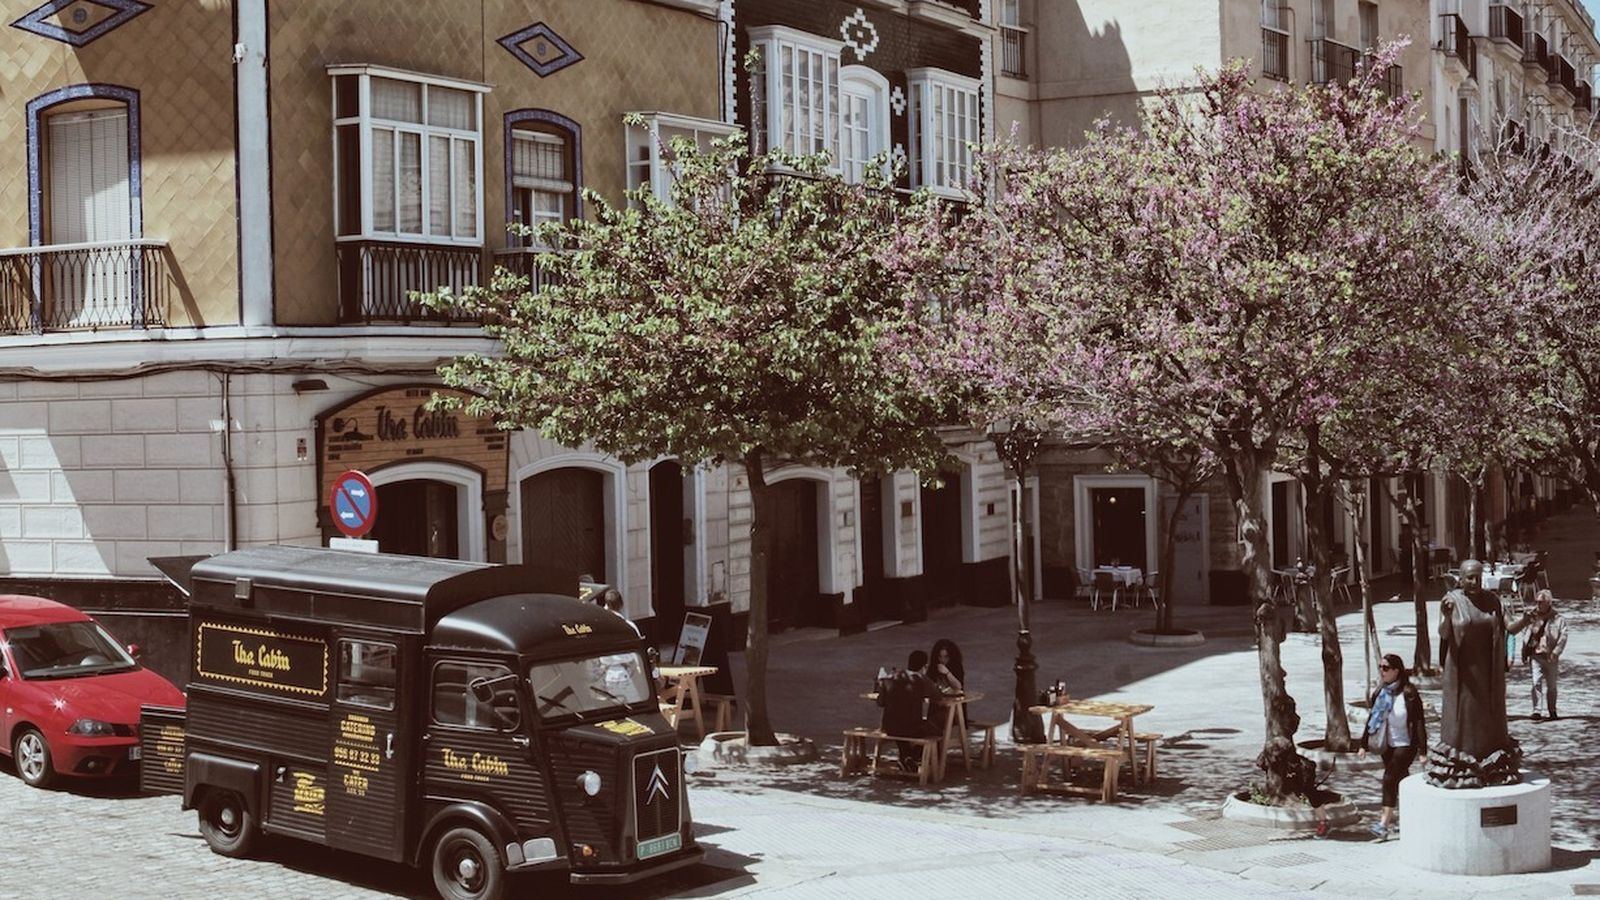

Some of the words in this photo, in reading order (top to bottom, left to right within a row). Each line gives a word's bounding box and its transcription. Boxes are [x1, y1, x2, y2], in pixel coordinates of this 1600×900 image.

[375, 406, 408, 441] The
[562, 624, 577, 635] The
[575, 624, 592, 634] Cabin
[232, 640, 255, 665] The
[258, 645, 290, 671] Cabin
[341, 720, 376, 736] CATERING
[441, 748, 467, 770] The
[472, 752, 508, 776] Cabin
[343, 774, 368, 790] CATER
